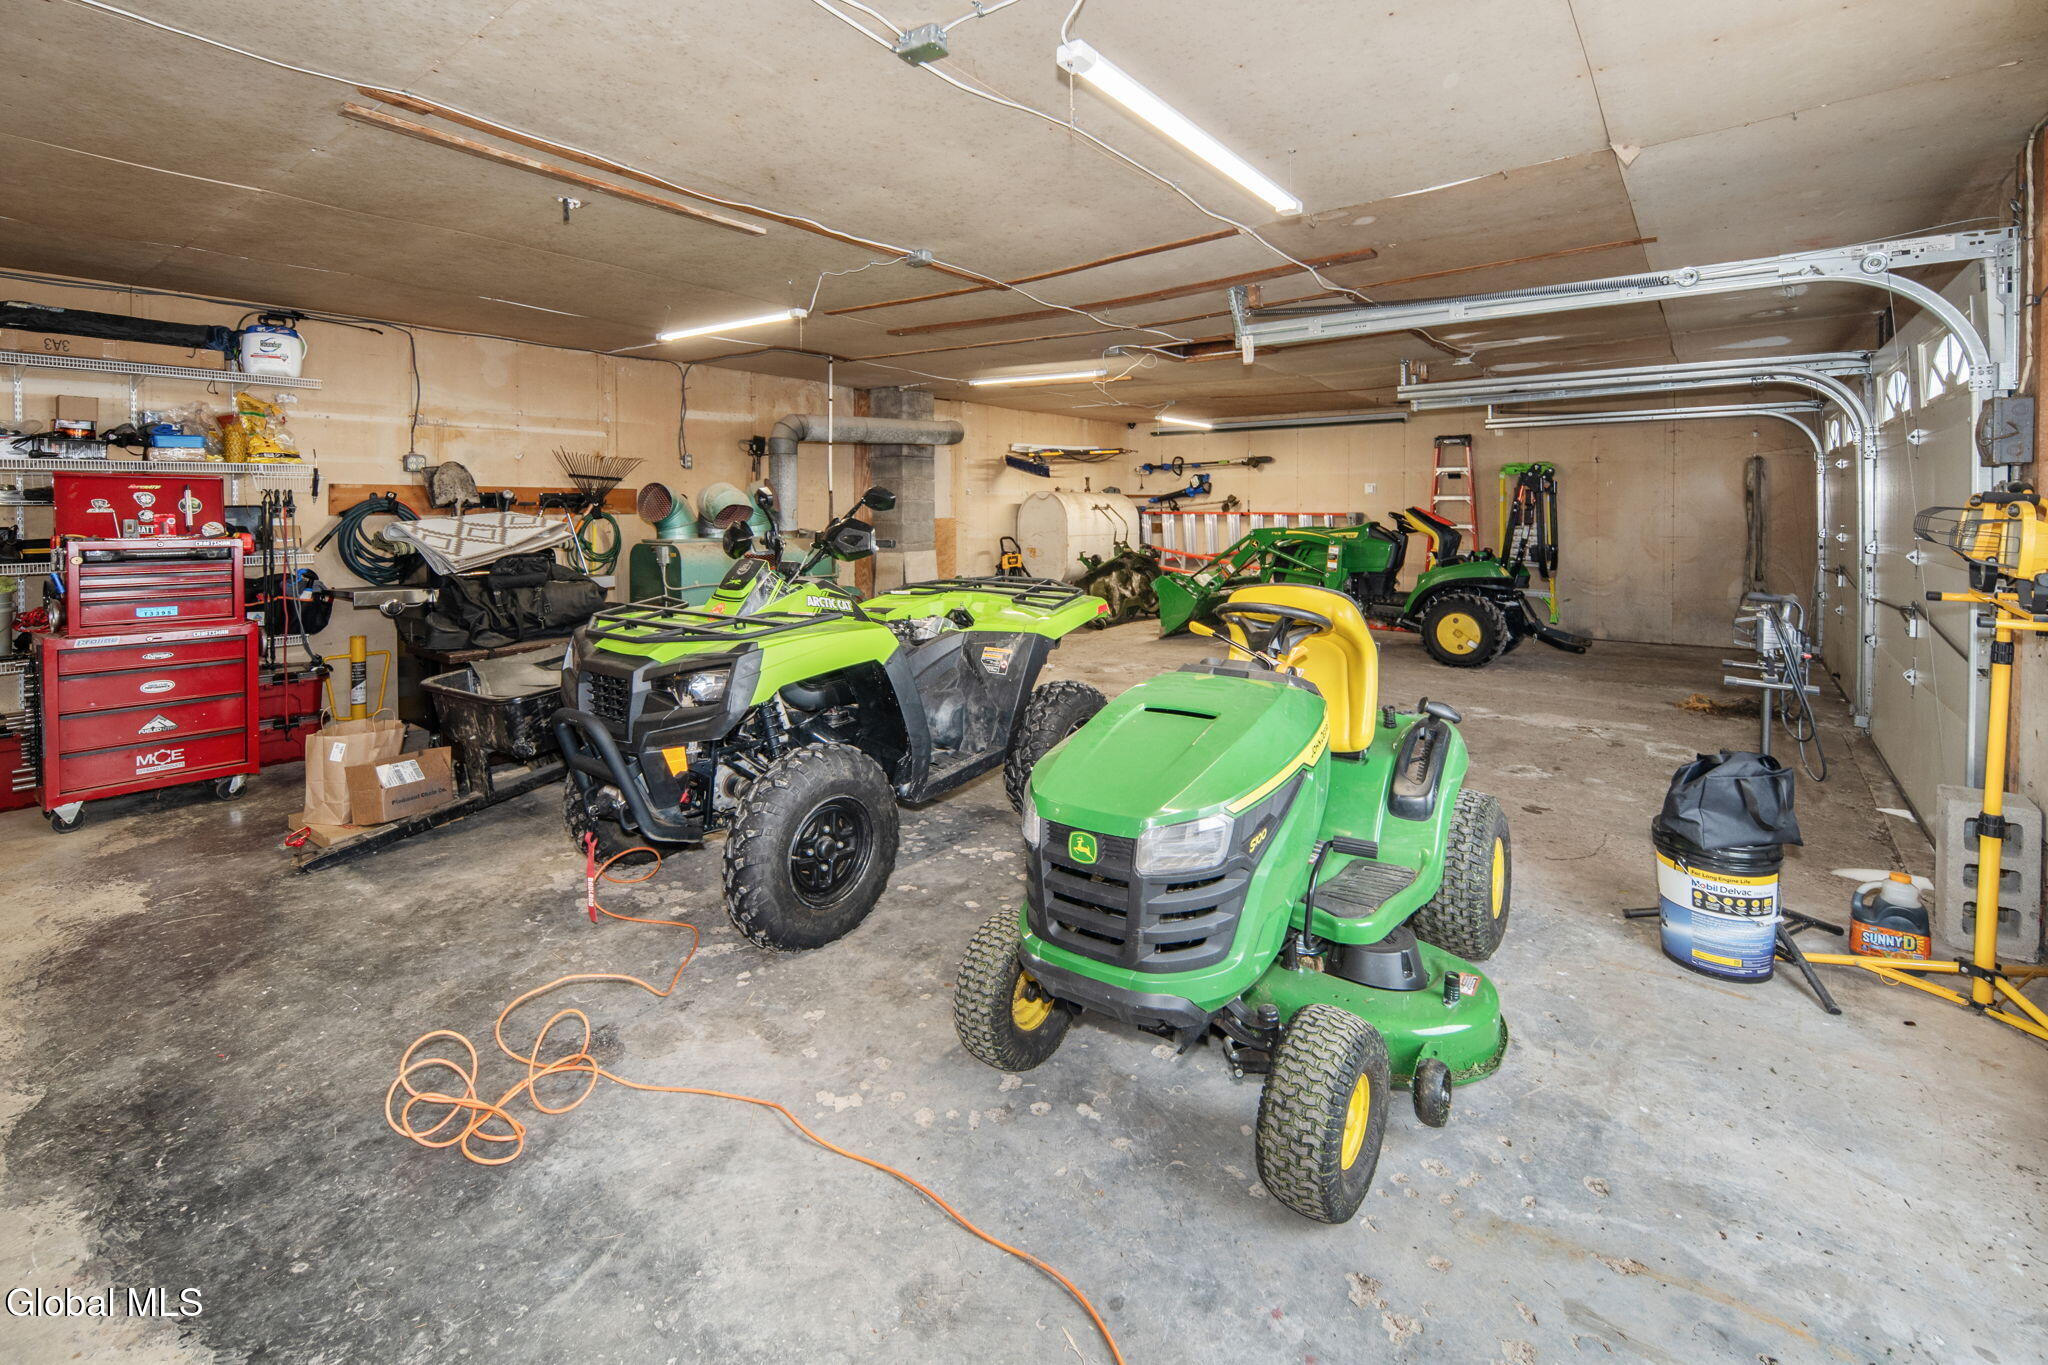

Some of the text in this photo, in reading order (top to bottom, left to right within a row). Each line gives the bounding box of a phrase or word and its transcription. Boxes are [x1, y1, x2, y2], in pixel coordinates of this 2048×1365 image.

[807, 596, 851, 610] ARCTIC CAT
[193, 629, 229, 637] CRAFTSMAN
[136, 748, 185, 766] MCE
[1702, 873, 1718, 881] Long
[1718, 876, 1739, 884] Engine
[1691, 879, 1718, 891] Mobil
[1719, 886, 1752, 897] Delvac
